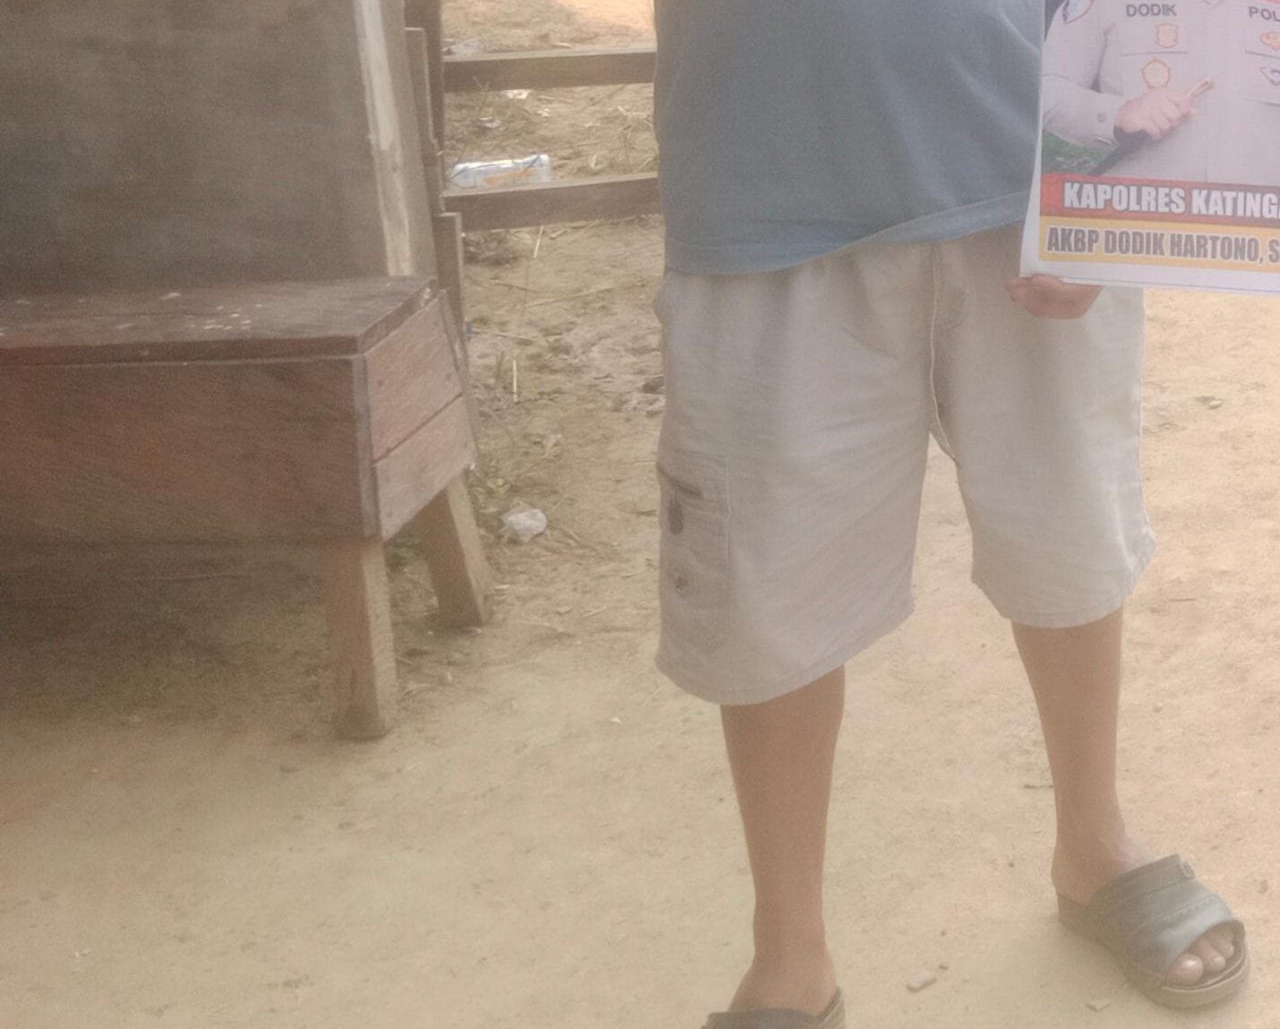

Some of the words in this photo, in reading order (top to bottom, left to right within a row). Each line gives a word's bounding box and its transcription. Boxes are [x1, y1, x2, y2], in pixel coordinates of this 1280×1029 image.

[1126, 4, 1178, 17] DODIK
[1063, 183, 1185, 214] KAPOLRES
[1047, 227, 1100, 253] AKBP
[1104, 230, 1165, 257] DODIK
[1169, 232, 1264, 264] HARTONO,
